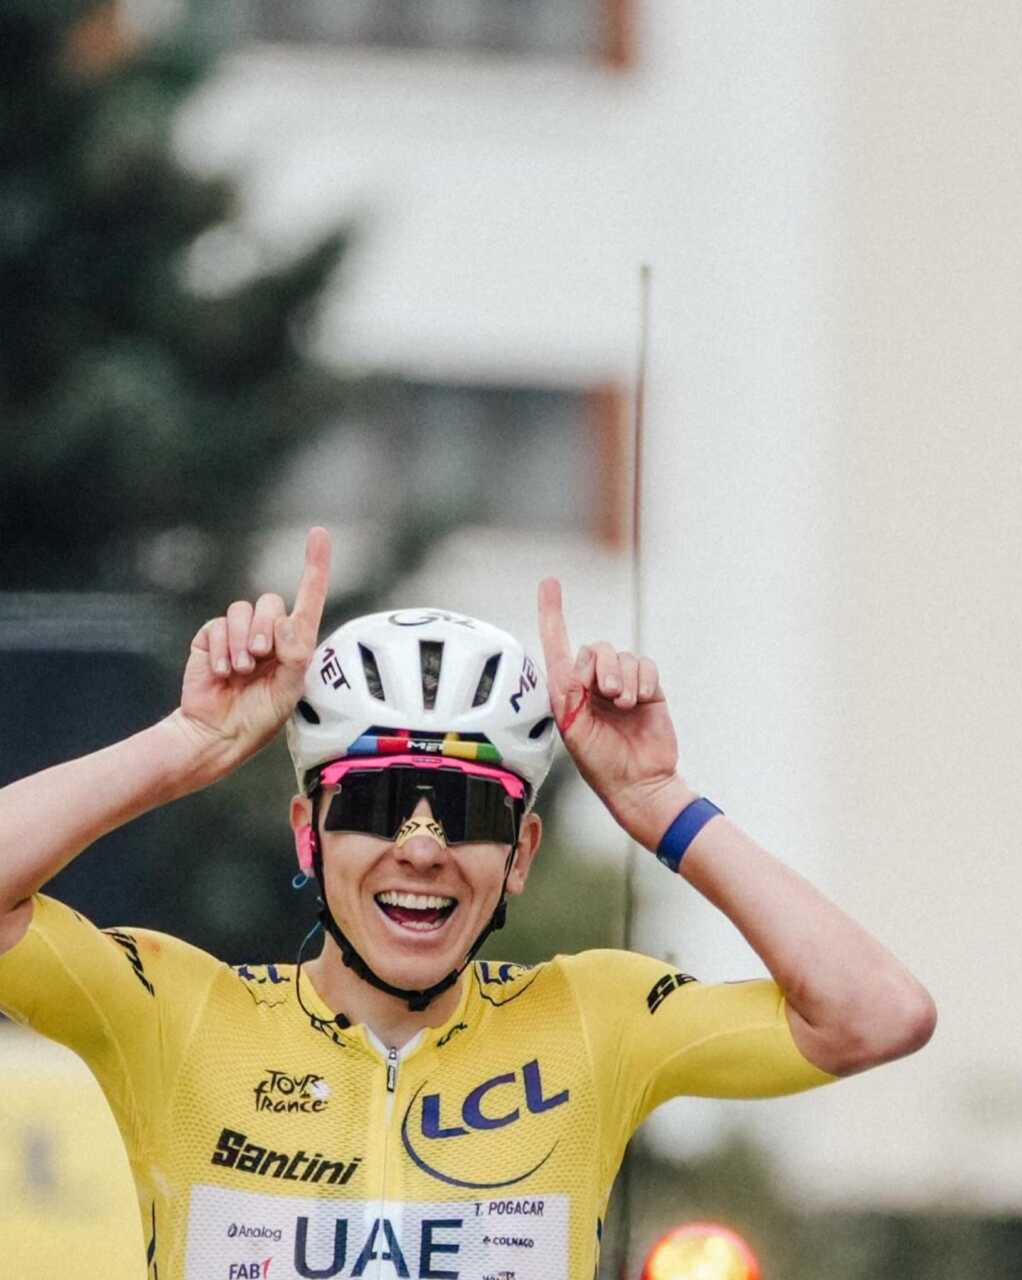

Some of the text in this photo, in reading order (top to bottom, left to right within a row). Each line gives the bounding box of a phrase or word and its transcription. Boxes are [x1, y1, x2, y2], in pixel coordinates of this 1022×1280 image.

[421, 1058, 569, 1140] LCL
[211, 1127, 362, 1186] Santini
[238, 1225, 282, 1242] Analog
[294, 1216, 464, 1280] UAE
[493, 1236, 535, 1249] COLNAGO
